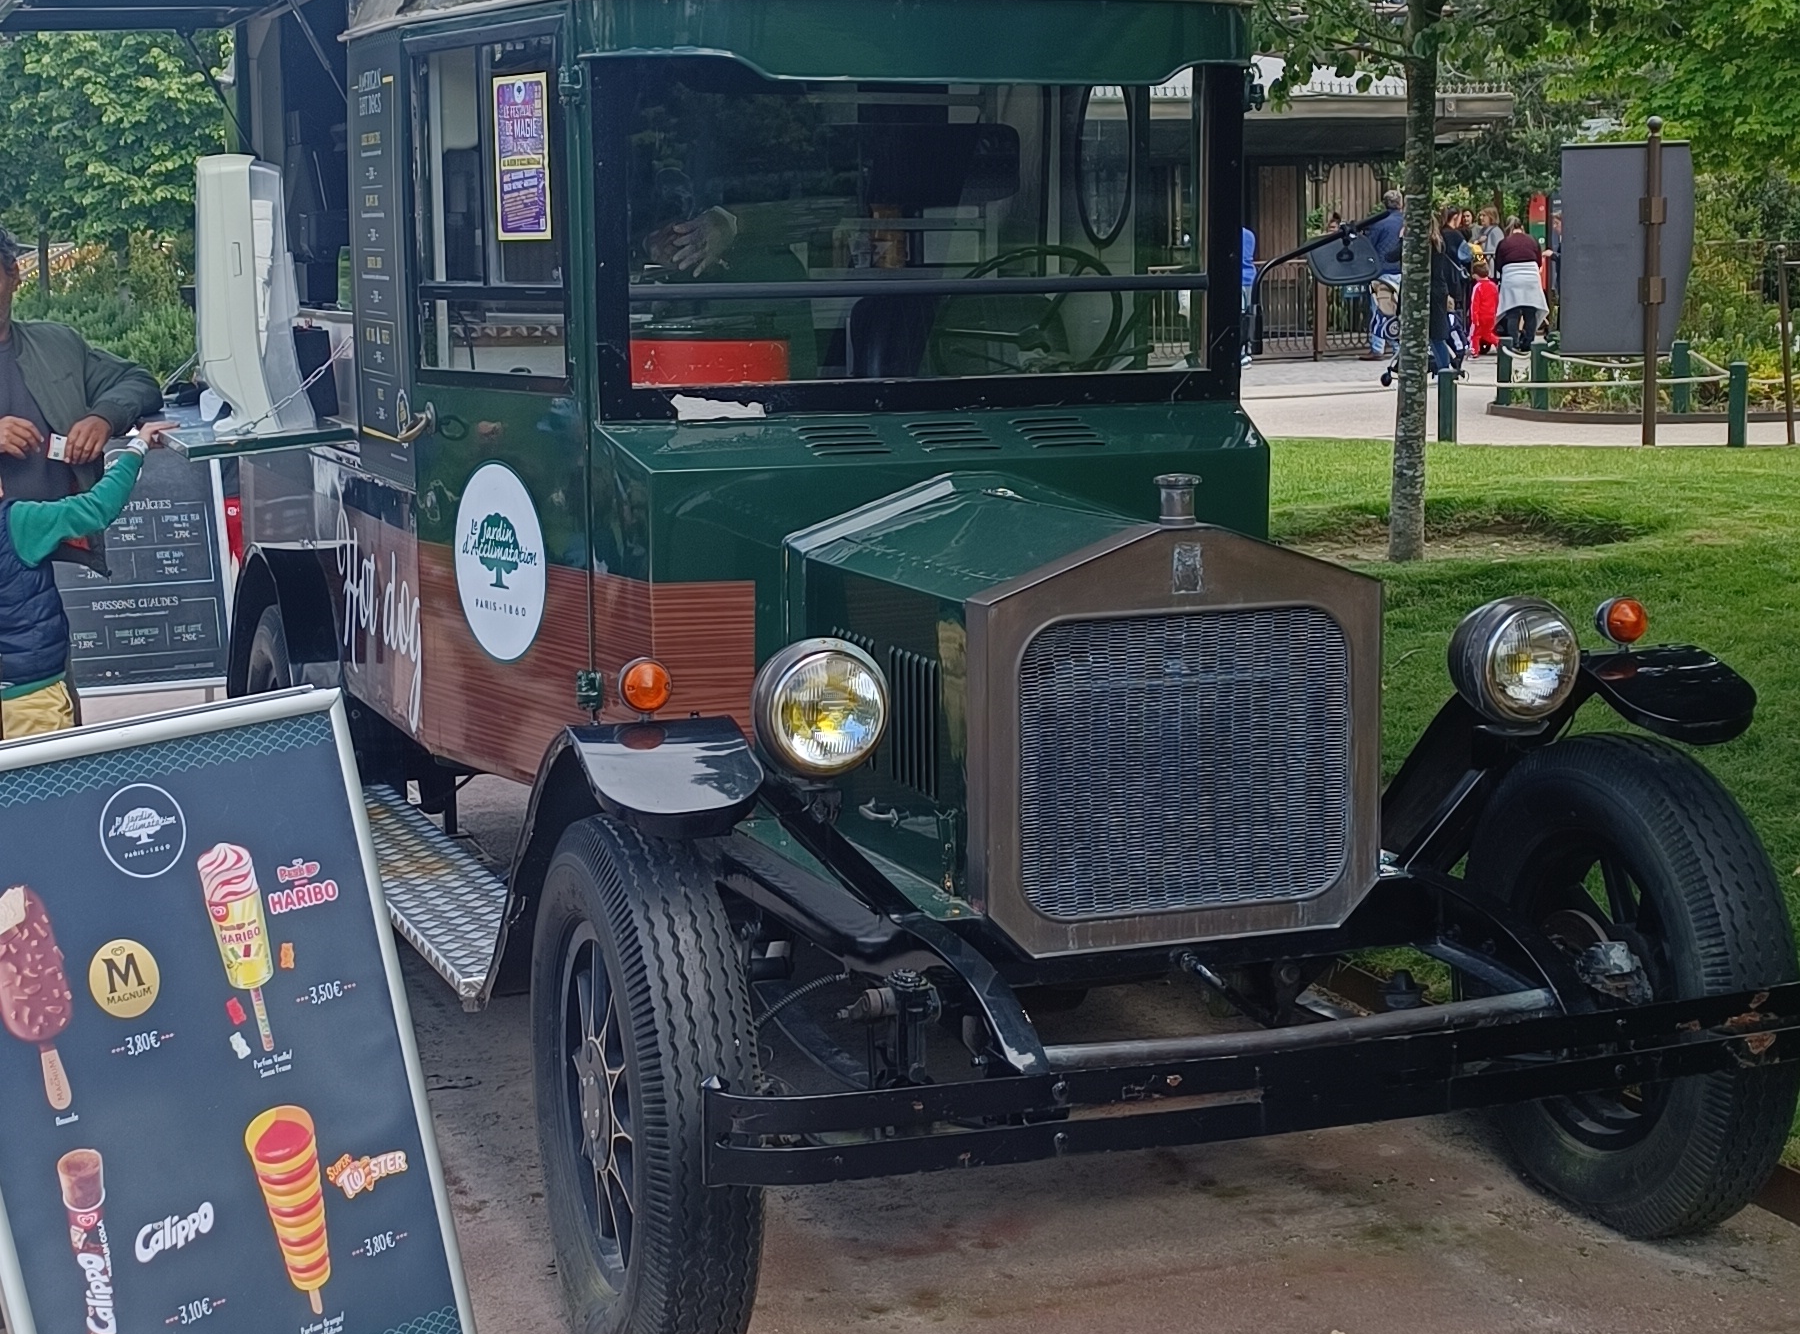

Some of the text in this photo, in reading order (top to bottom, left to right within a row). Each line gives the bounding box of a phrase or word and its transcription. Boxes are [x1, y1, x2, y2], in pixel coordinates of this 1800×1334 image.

[503, 106, 510, 119] LE
[506, 118, 538, 138] DE MAGIE
[470, 518, 515, 543] Le Jardin
[462, 534, 538, 566] d'Acclimatation
[92, 596, 179, 611] BOISSONS CHAUDES
[336, 477, 422, 734] Hot dog
[127, 810, 154, 824] Jardin
[269, 881, 338, 914] HARIBO
[220, 925, 261, 944] HARIBO
[101, 952, 146, 994] M
[106, 986, 153, 1005] MAGNUM
[308, 980, 343, 1004] 3,50€
[125, 1030, 160, 1056] 3,80€
[48, 1059, 65, 1101] MAGNUM
[326, 1153, 352, 1182] SUPER
[96, 1219, 108, 1244] COLA
[135, 1201, 214, 1263] Calippo
[364, 1230, 396, 1257] 3,80€
[178, 1297, 213, 1325] 3,10€
